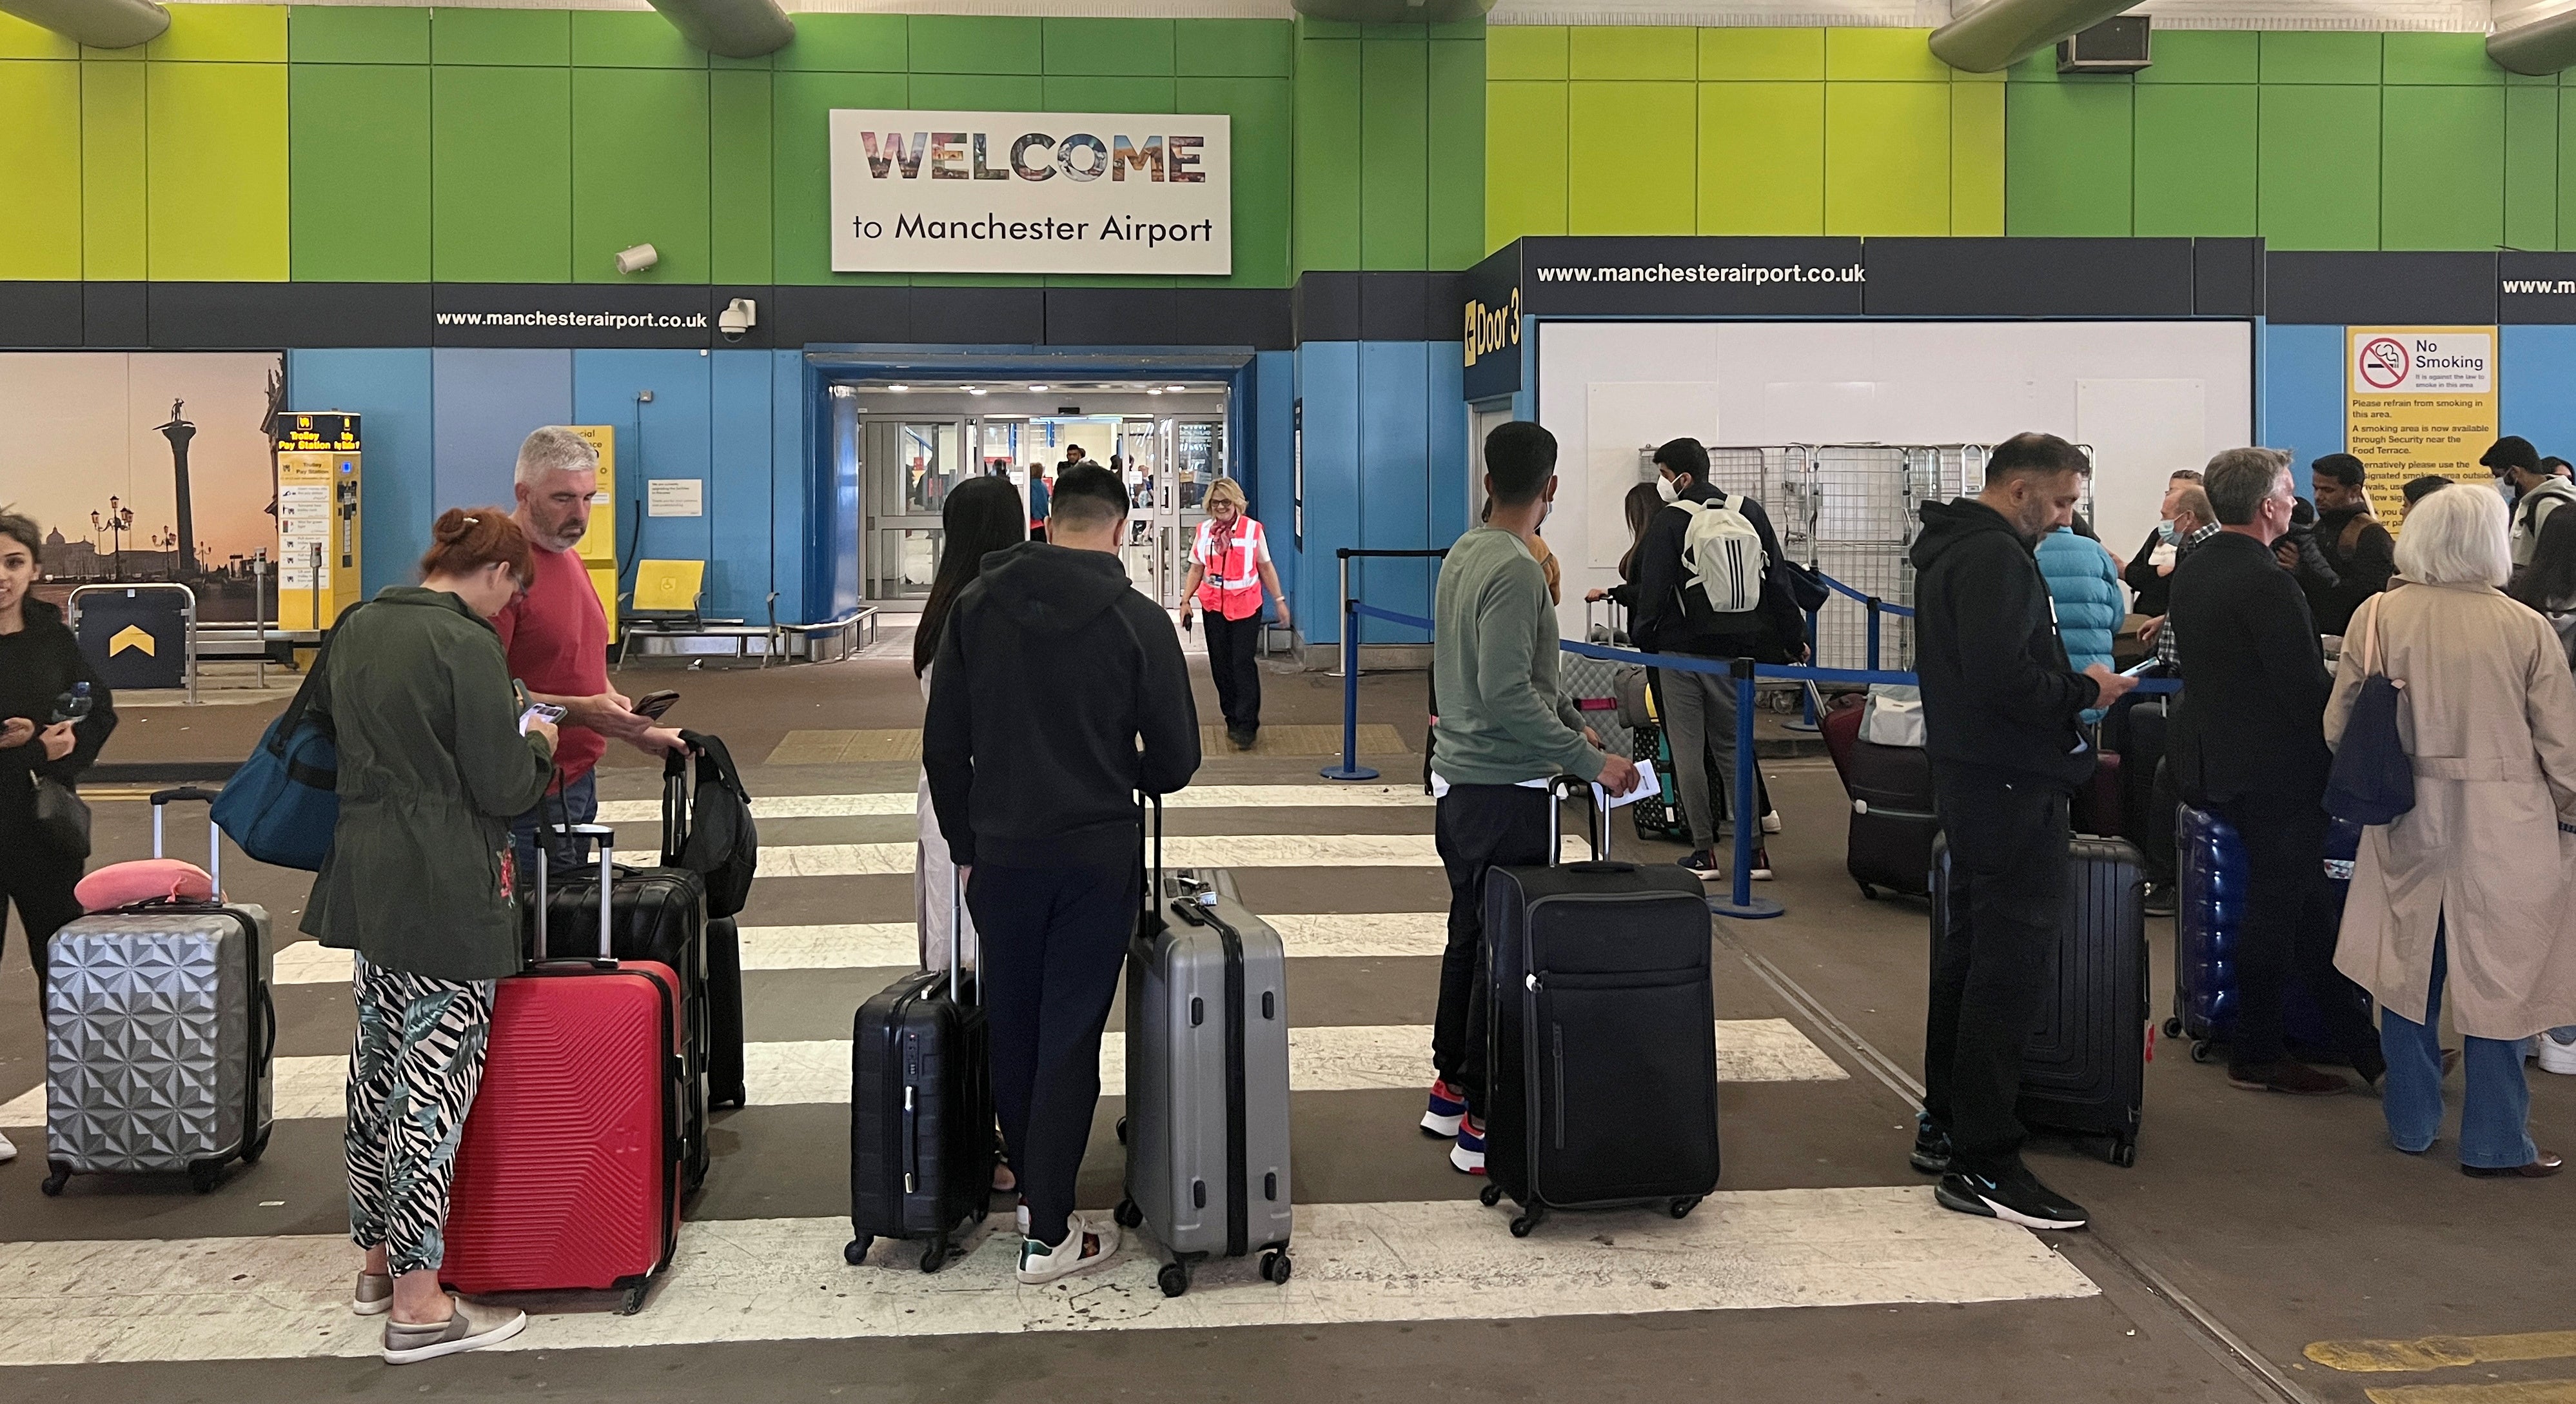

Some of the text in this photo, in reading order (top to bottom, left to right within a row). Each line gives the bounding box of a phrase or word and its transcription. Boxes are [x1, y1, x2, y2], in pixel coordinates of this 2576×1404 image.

[861, 131, 1205, 183] WELCOME
[852, 213, 1212, 248] to Manchester Airport
[1537, 263, 1865, 286] www.manchesterairport.co.uk
[437, 311, 707, 329] www.manchesterairport.co.uk
[1477, 287, 1520, 355] Door 3
[2416, 340, 2437, 352] No
[2416, 355, 2483, 371] Smoking
[2436, 400, 2473, 408] smoking
[580, 429, 595, 438] cial
[2361, 425, 2398, 434] smoking
[290, 431, 320, 441] Trolley
[2353, 436, 2386, 444] through
[2388, 436, 2423, 444] Security
[278, 440, 295, 451] Pay
[298, 440, 331, 450] Station
[2365, 461, 2406, 470] ernatively
[2408, 461, 2436, 470] please
[2365, 472, 2400, 481] signated
